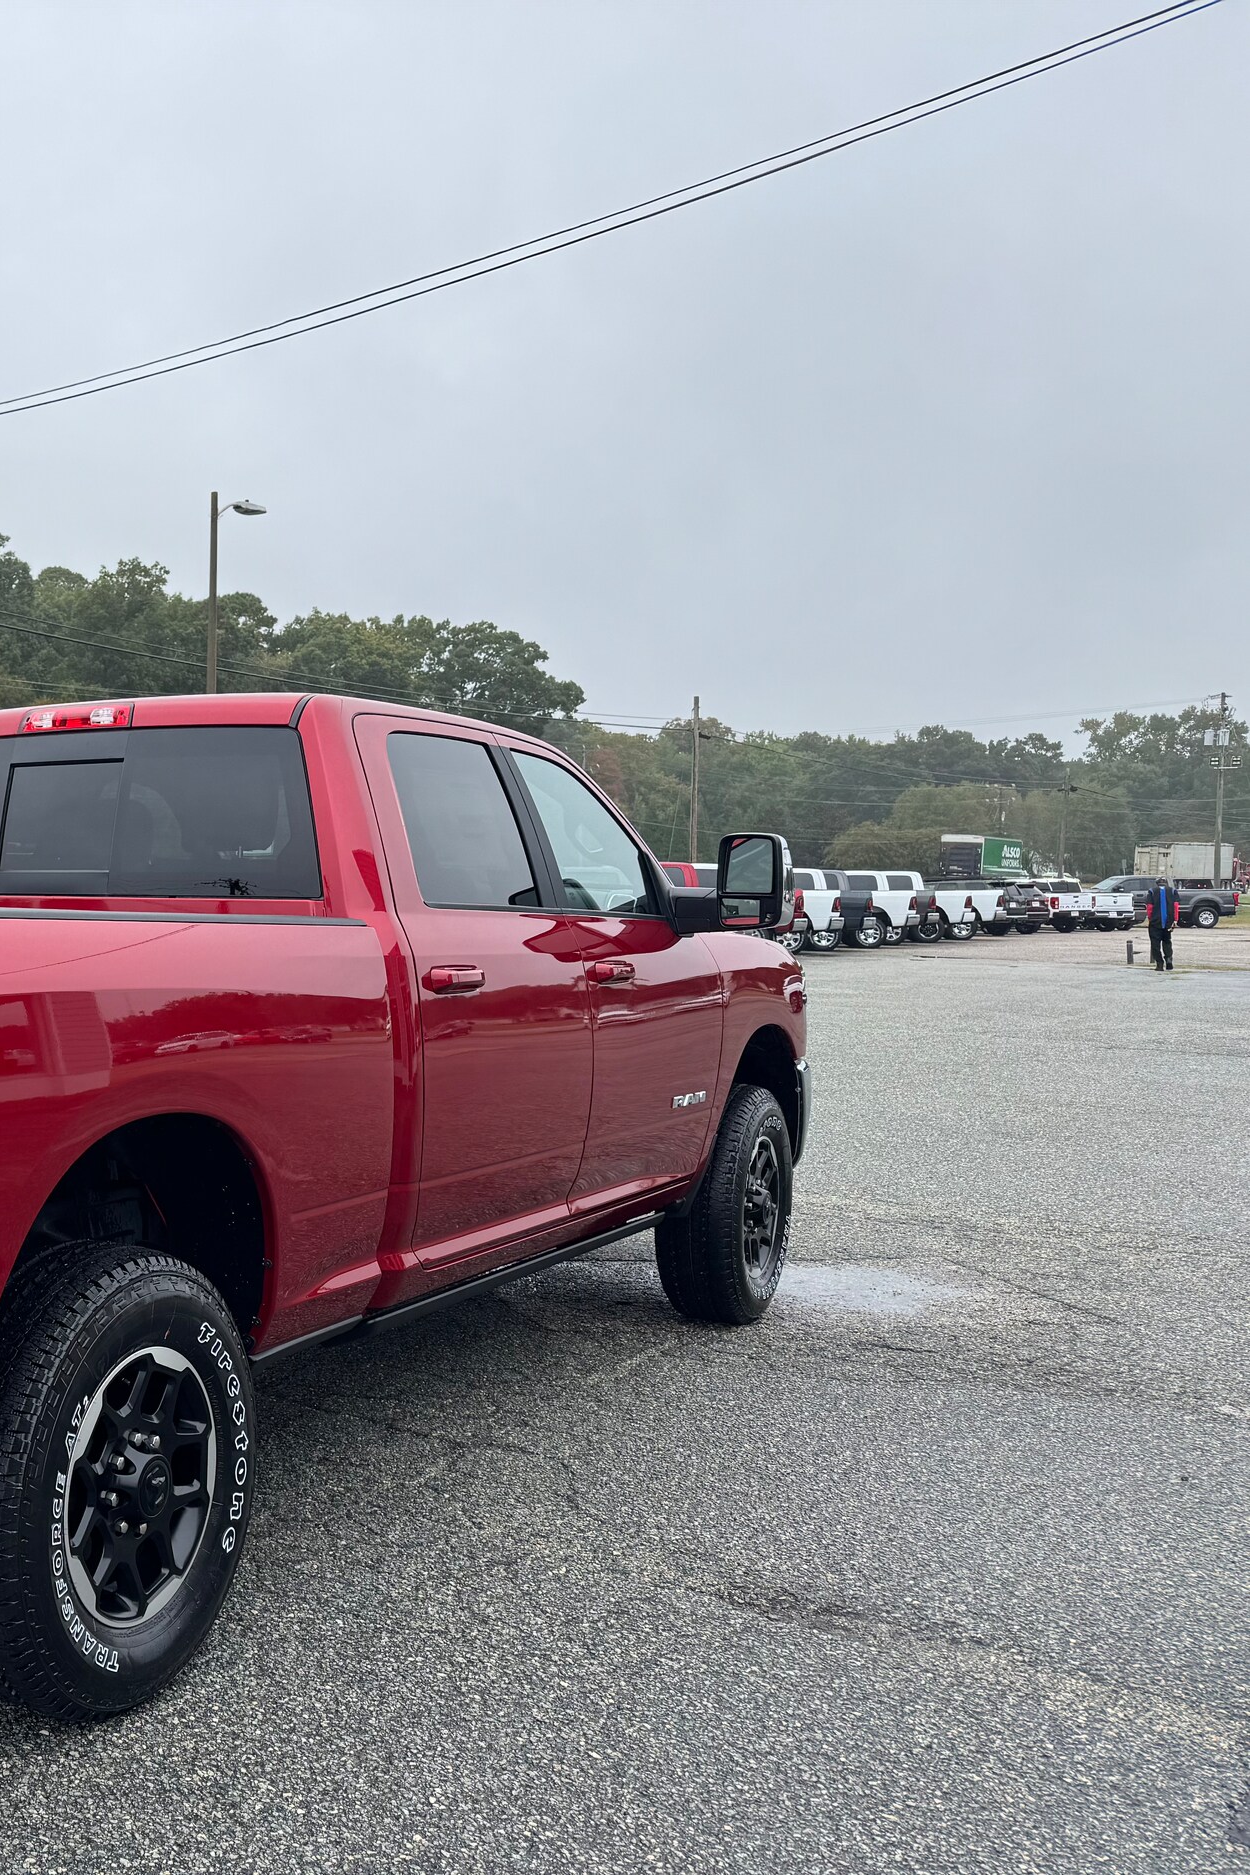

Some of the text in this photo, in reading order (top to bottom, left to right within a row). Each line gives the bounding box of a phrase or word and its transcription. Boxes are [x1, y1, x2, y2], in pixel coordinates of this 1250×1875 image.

[671, 1091, 706, 1108] RAM
[197, 1321, 249, 1554] Firestone
[52, 1470, 120, 1673] TRANSFORCE
